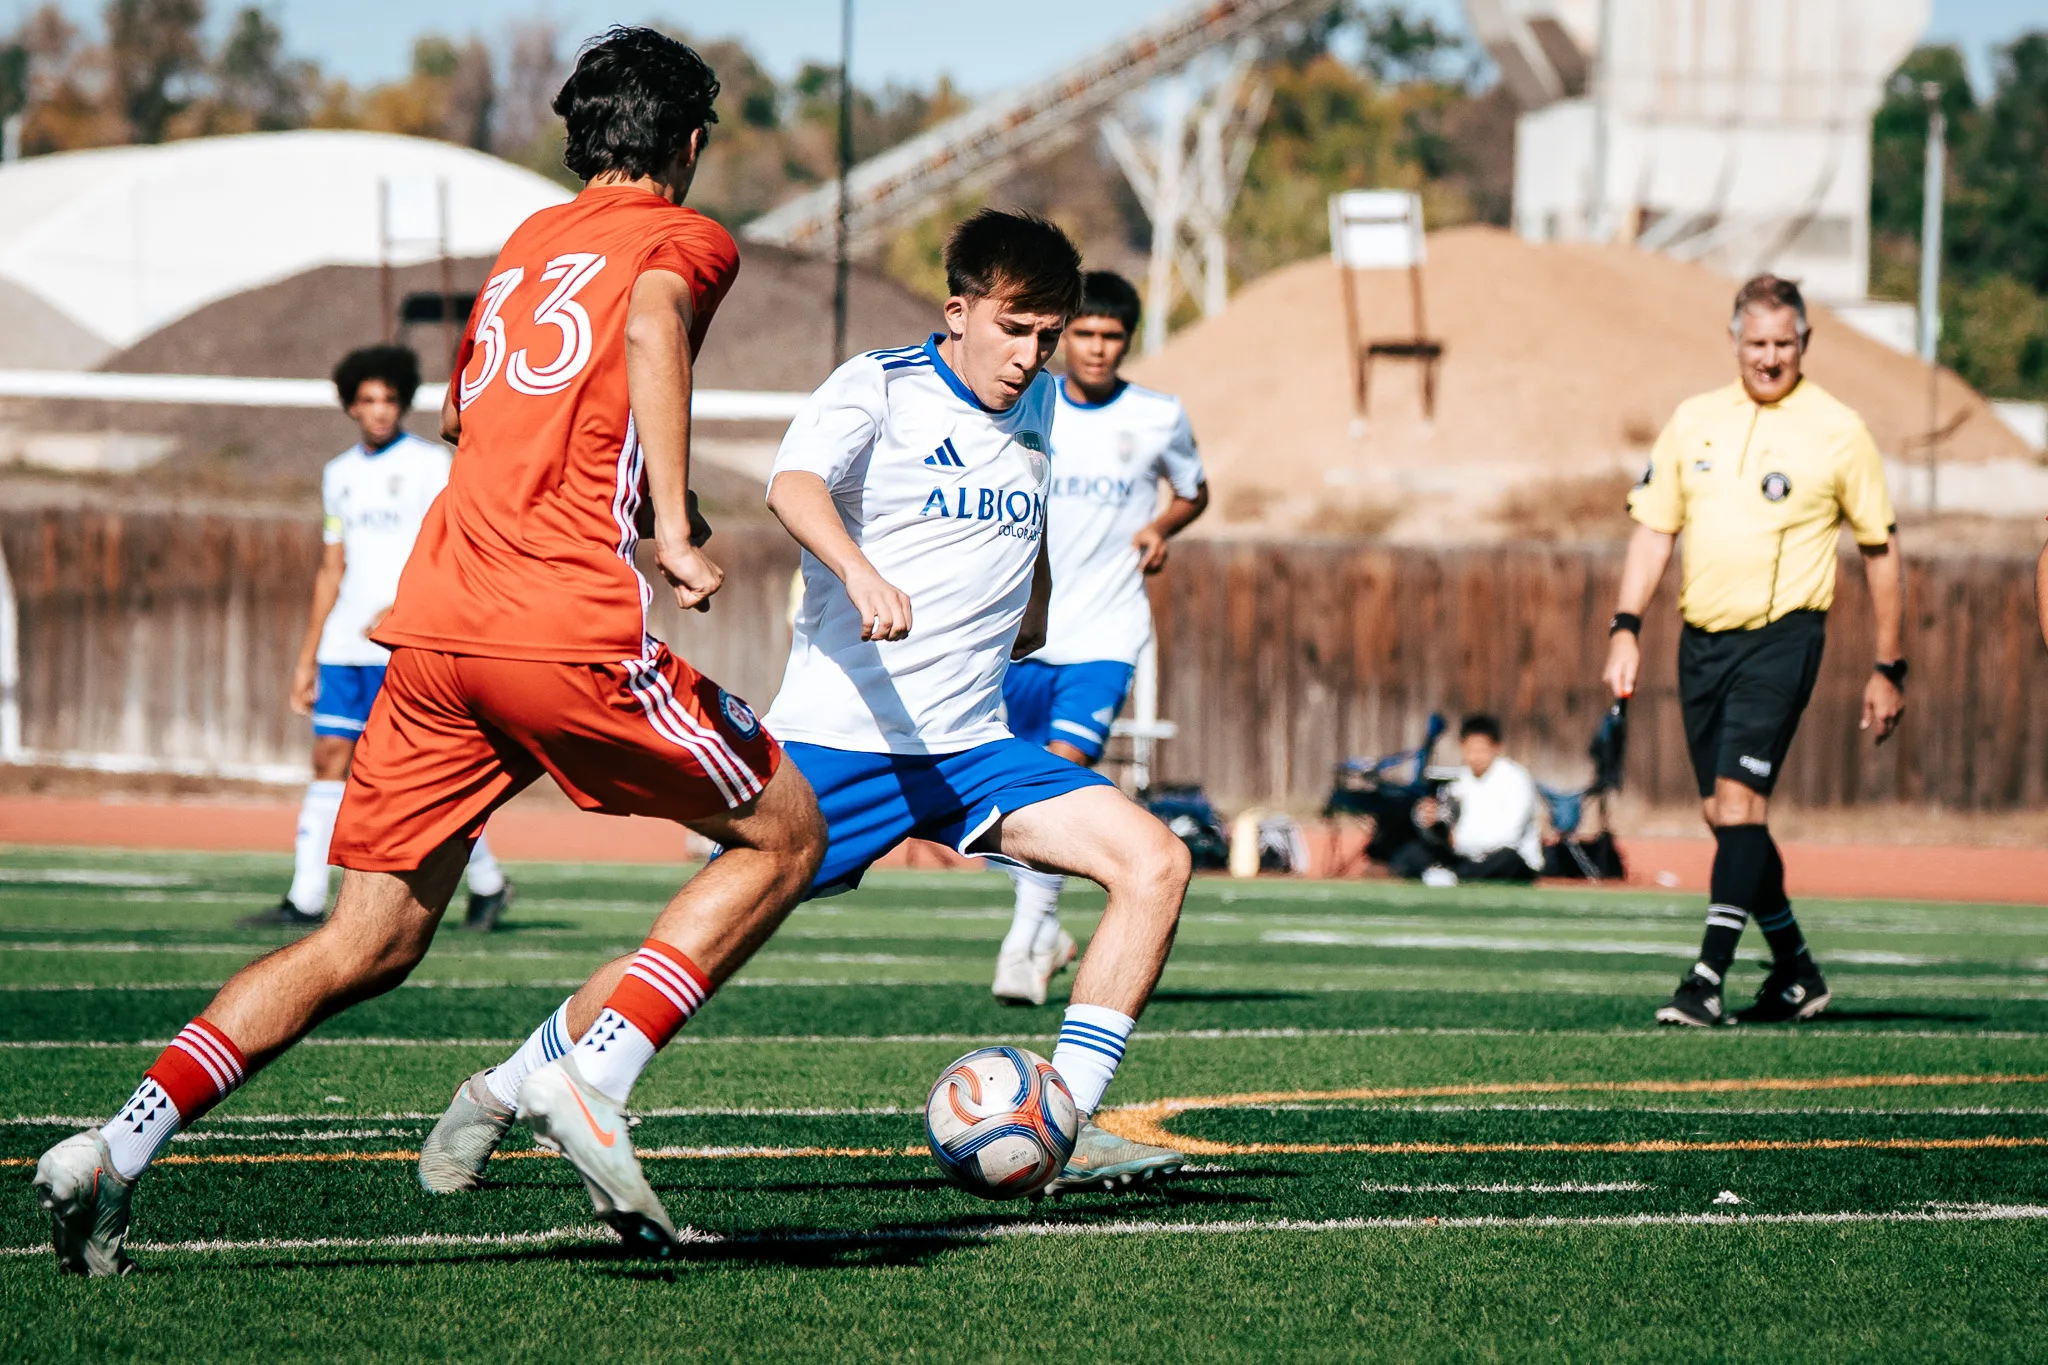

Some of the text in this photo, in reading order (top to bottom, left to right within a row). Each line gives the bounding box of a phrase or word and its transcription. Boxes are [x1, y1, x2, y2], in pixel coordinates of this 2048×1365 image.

[460, 253, 606, 411] 33
[919, 486, 1047, 525] ALBION
[1050, 476, 1135, 500] LBION
